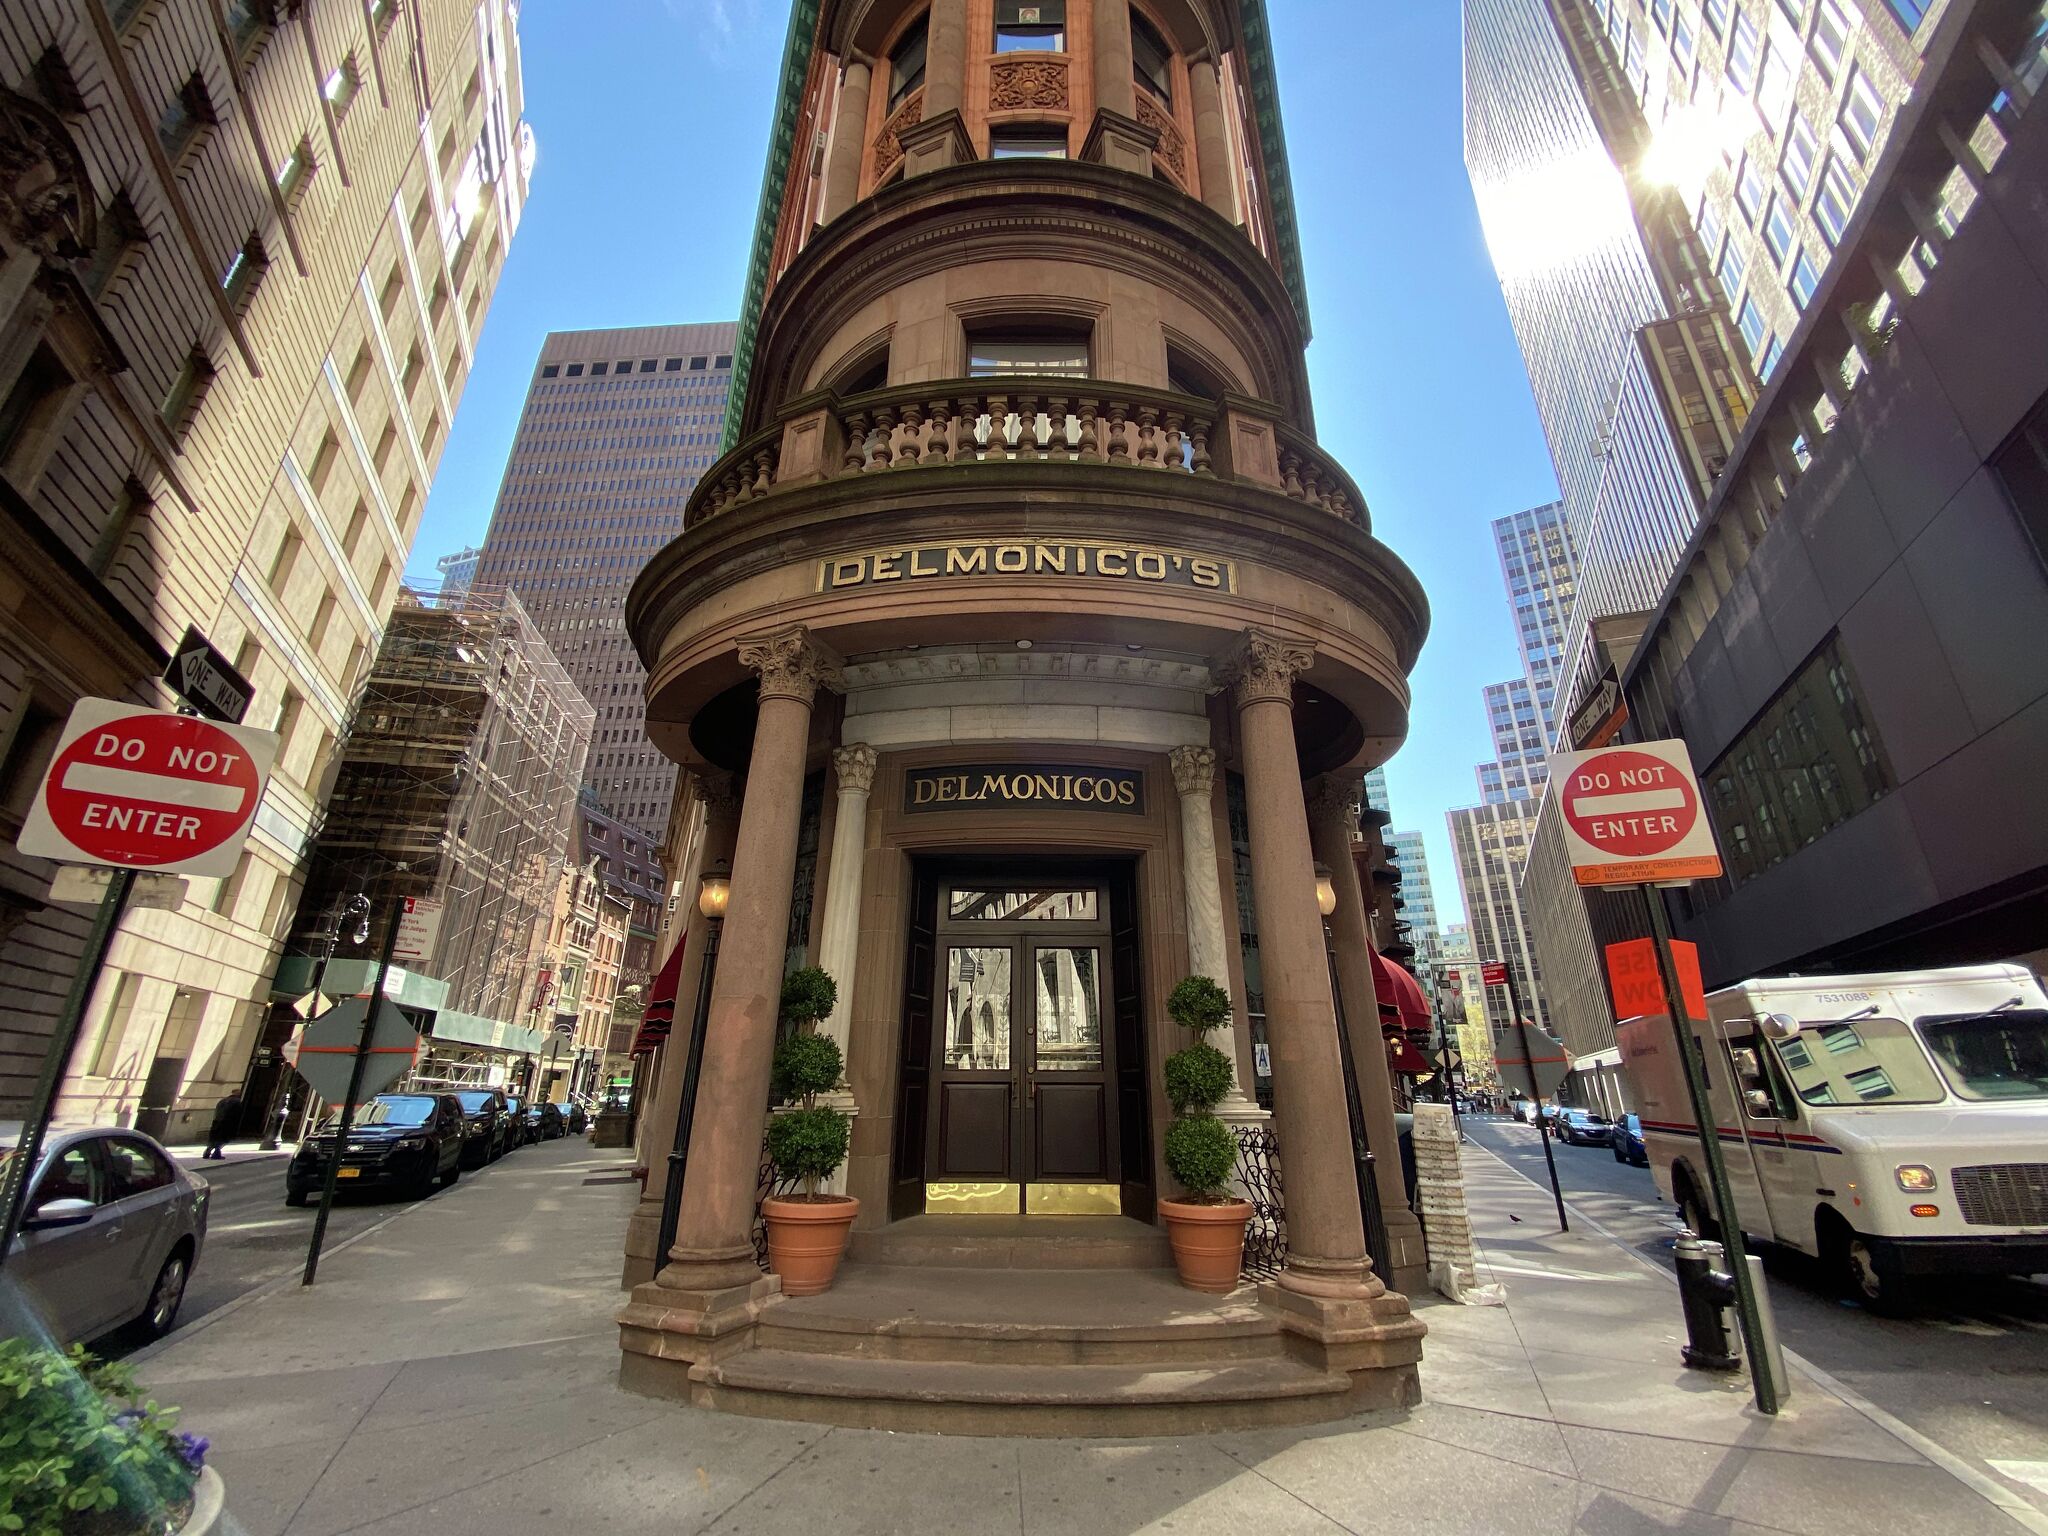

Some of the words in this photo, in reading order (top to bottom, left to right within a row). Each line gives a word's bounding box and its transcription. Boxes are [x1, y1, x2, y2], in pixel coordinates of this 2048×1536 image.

[830, 545, 1222, 588] DELMONICO'S
[186, 655, 213, 690] ONE
[215, 681, 243, 716] WAY
[1575, 715, 1591, 740] ONE
[1595, 685, 1612, 714] WAY
[93, 733, 145, 761] DO
[167, 746, 240, 776] NOT
[913, 773, 1136, 805] DELMONICOS
[1578, 773, 1610, 792] DO
[1619, 766, 1666, 787] NOT
[81, 803, 202, 840] ENTER
[1591, 815, 1679, 840] ENTER
[1603, 863, 1650, 873] TEMPORARY
[1652, 858, 1713, 869] CONSTRUCTION
[1604, 870, 1656, 880] REGULATION
[1815, 992, 1870, 1004] 7531088
[1259, 1048, 1268, 1067] A
